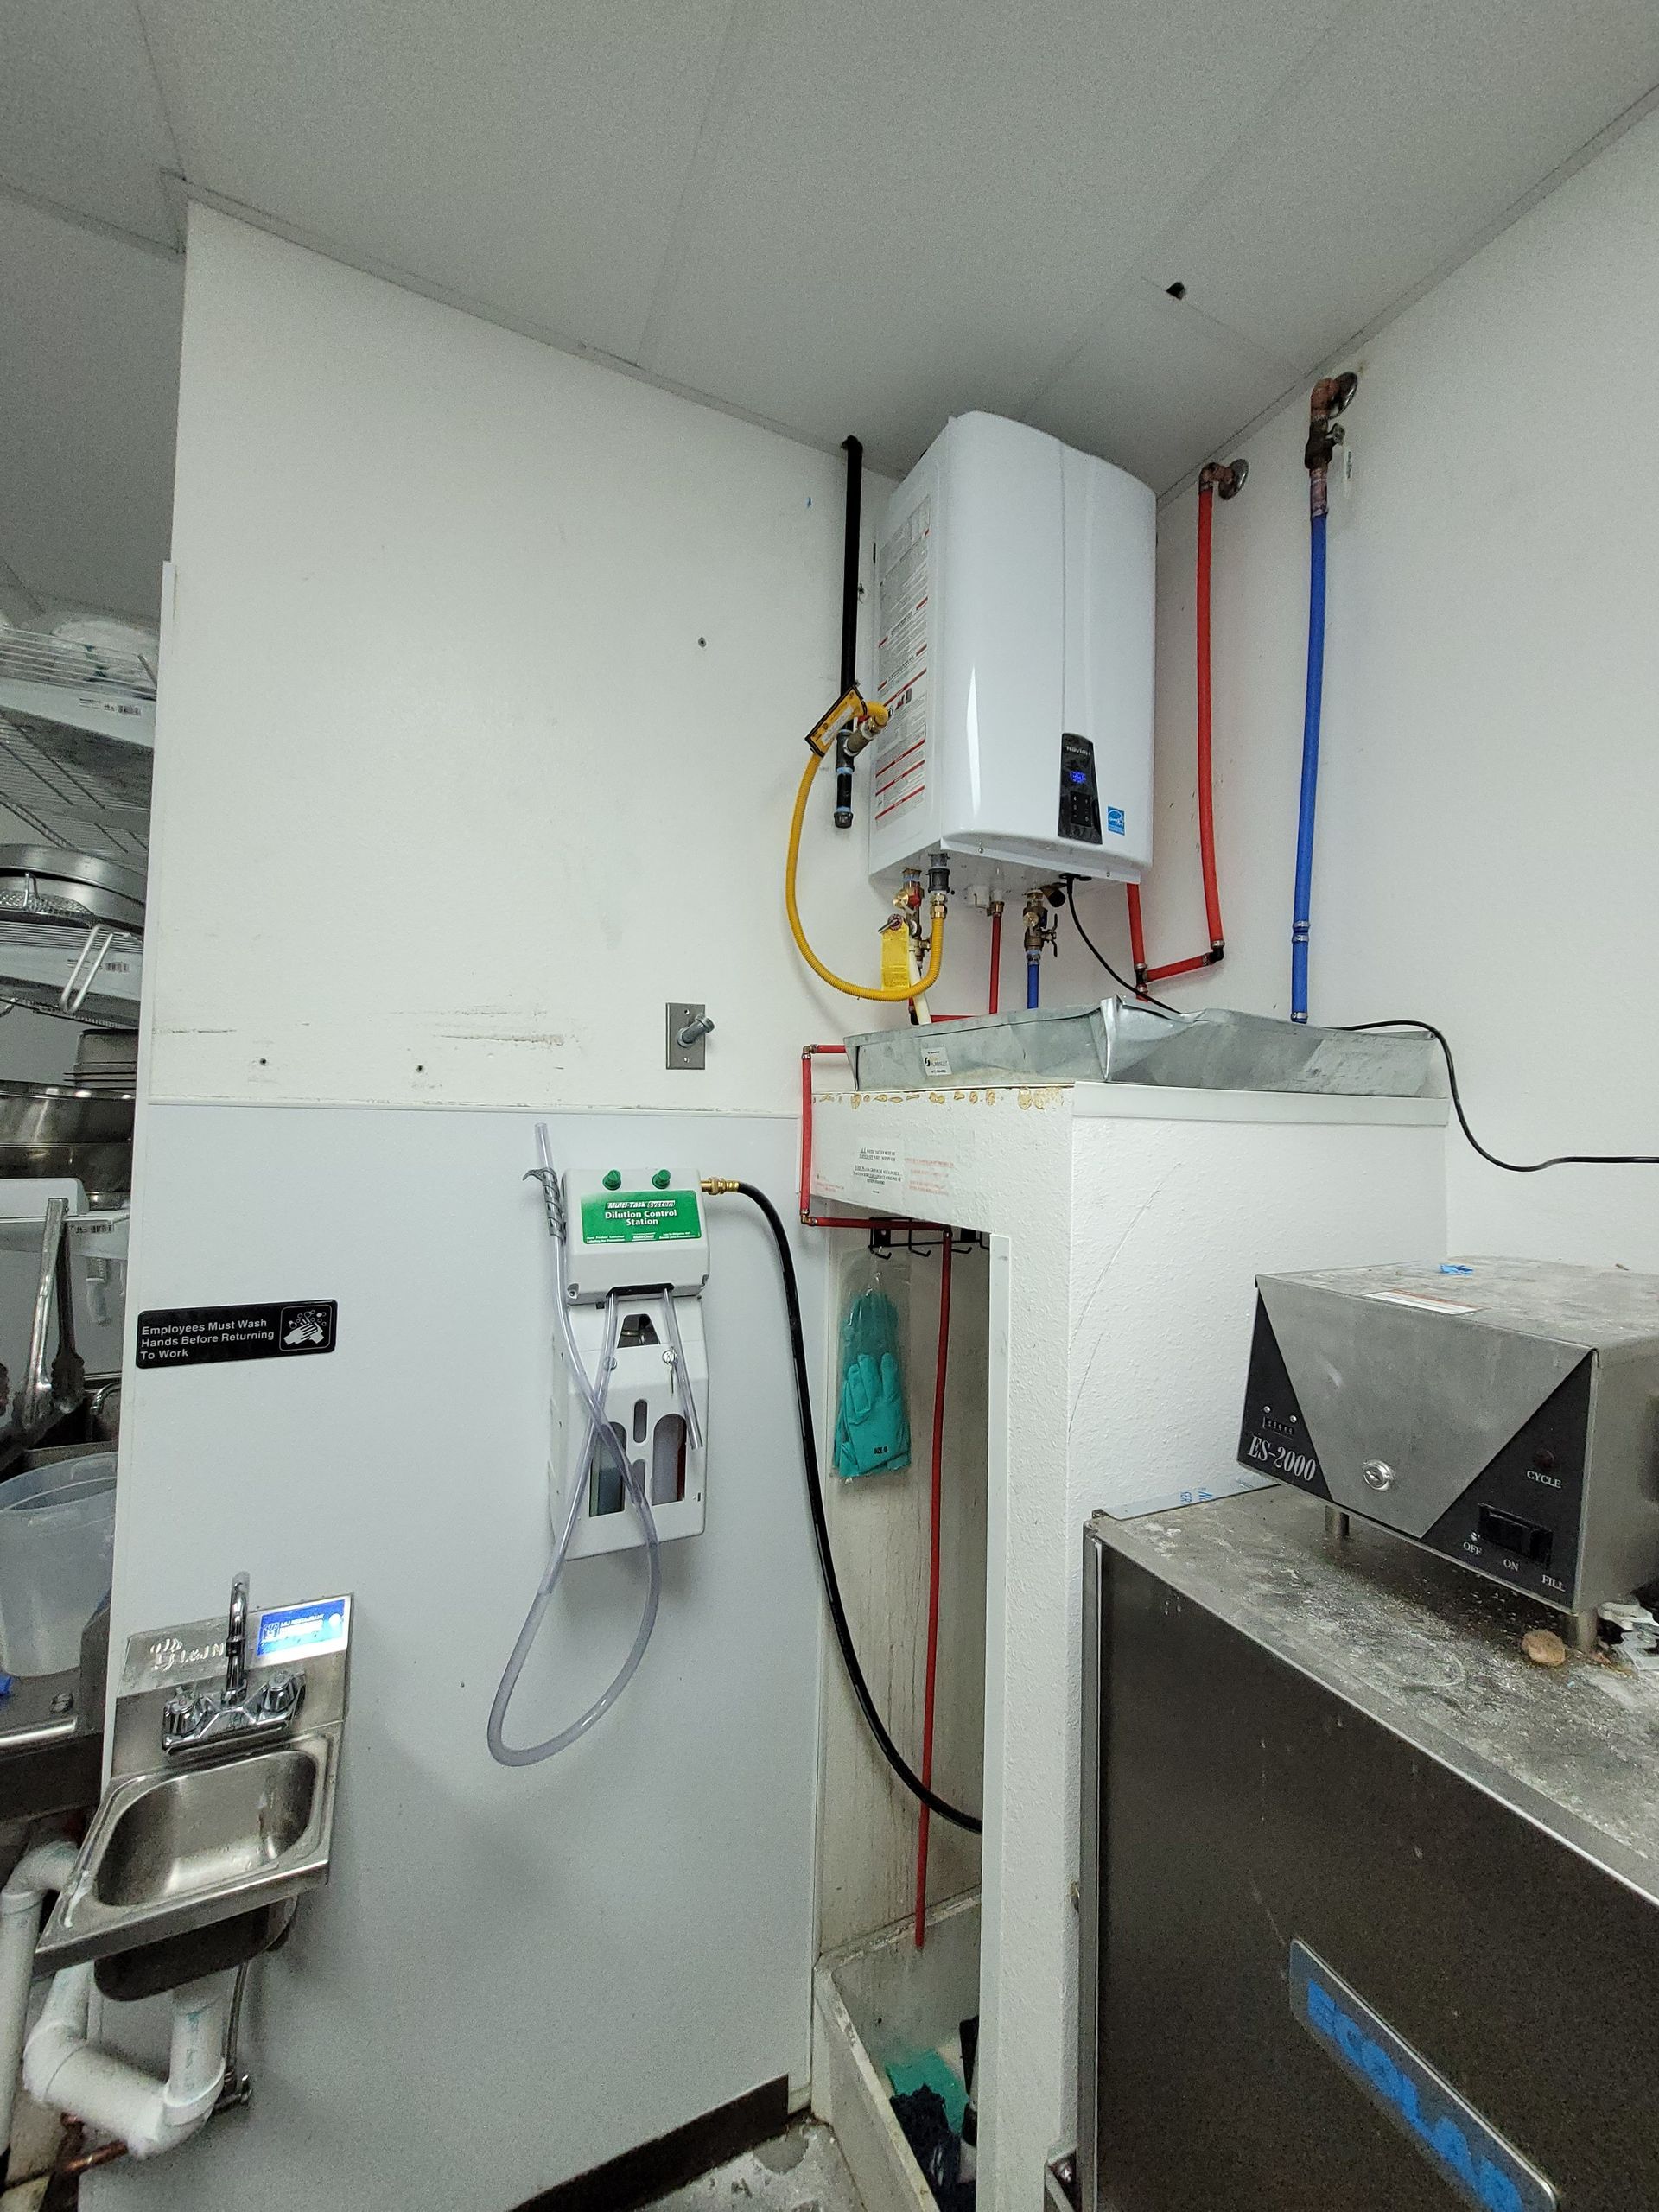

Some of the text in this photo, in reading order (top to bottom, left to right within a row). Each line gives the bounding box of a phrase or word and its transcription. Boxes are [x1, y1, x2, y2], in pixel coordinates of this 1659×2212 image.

[605, 1209, 677, 1219] Dilution Control
[142, 1319, 268, 1337] Employees Must Wash
[141, 1331, 275, 1348] Hands Before Returning
[140, 1348, 188, 1360] To Work
[1247, 1434, 1317, 1482] ES-2000
[1526, 1470, 1562, 1489] CYCLE
[1463, 1541, 1483, 1556] OFF
[1503, 1558, 1520, 1572] ON
[1541, 1574, 1567, 1592] FILL
